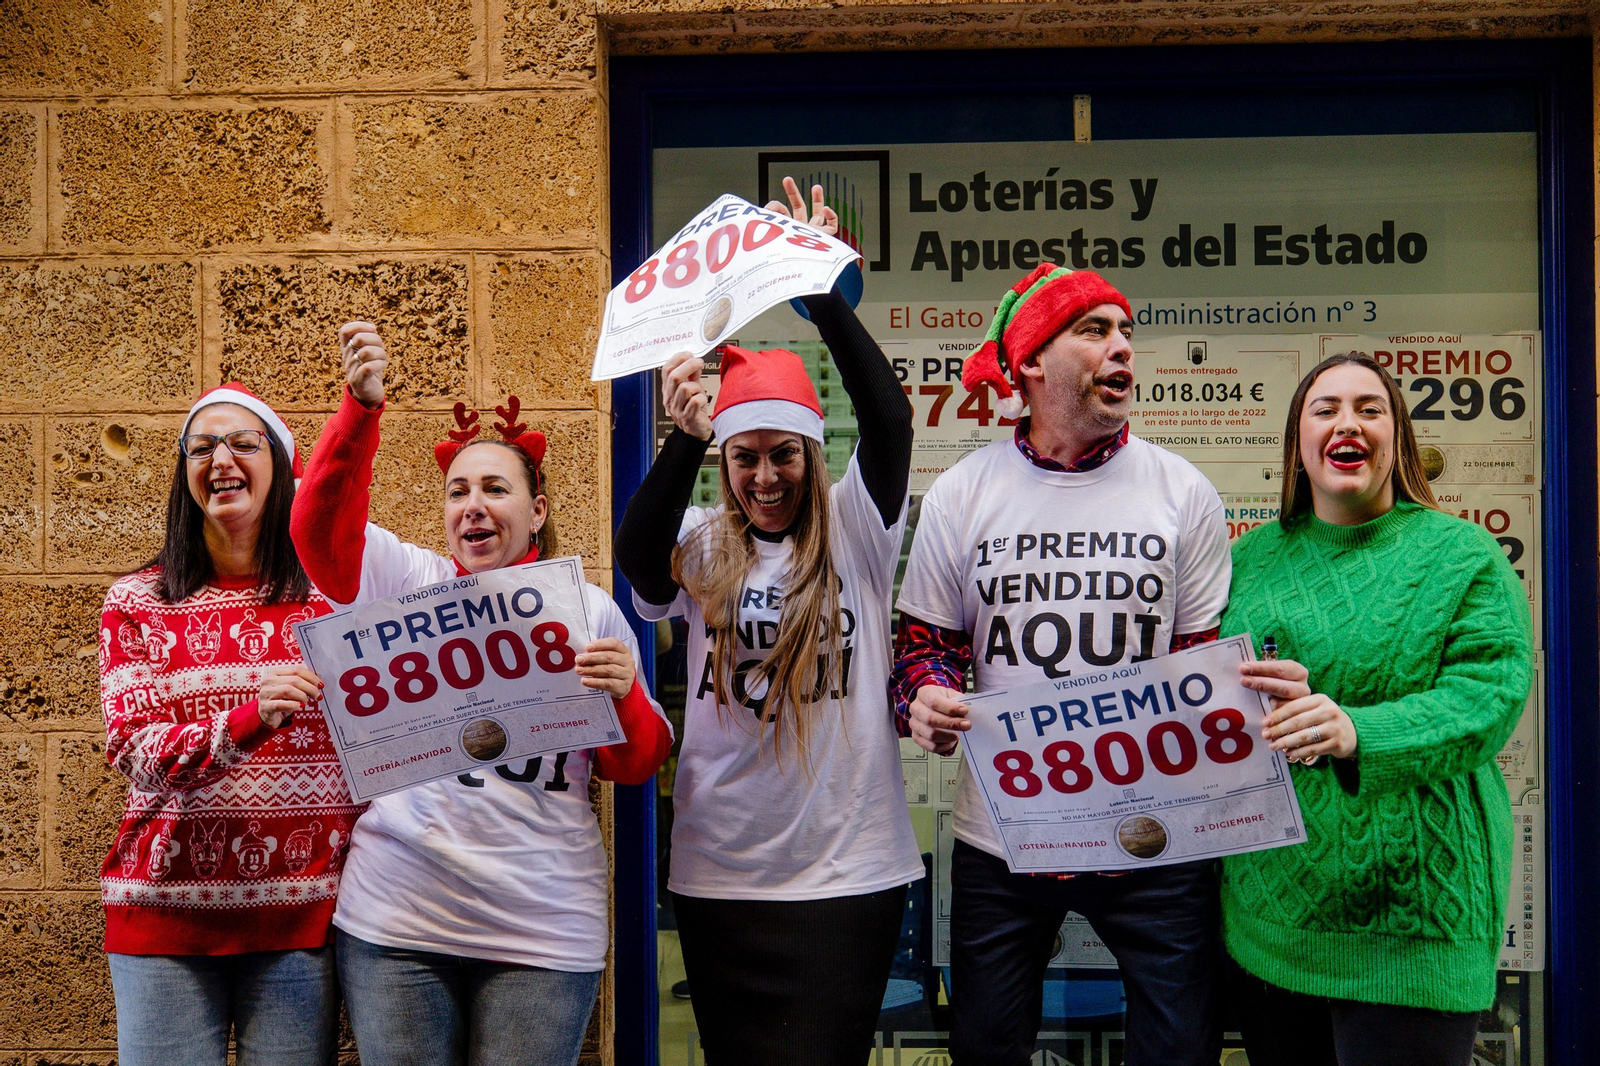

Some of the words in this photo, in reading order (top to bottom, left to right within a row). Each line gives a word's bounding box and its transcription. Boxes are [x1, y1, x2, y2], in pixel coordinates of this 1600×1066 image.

[909, 167, 1114, 213] Loterías
[1129, 178, 1159, 222] y
[624, 218, 833, 304] 88008
[911, 227, 1146, 282] Apuestas
[1161, 222, 1237, 268] del
[1253, 220, 1428, 266] Estado
[757, 272, 804, 293] DICIEMBRE
[671, 305, 684, 314] HAY
[890, 307, 910, 329] El
[920, 307, 984, 329] Gato
[1363, 301, 1377, 322] 3
[1388, 335, 1435, 344] VENDIDO
[1437, 333, 1462, 344] AQUÍ
[1156, 367, 1188, 375] Hemos
[1190, 367, 1238, 376] entregado
[1373, 349, 1513, 376] PREMIO
[1134, 382, 1243, 403] 1.018.034
[1249, 382, 1265, 403] €
[1142, 408, 1179, 418] premios
[1190, 408, 1199, 417] lo
[1201, 408, 1226, 418] largo
[1228, 408, 1240, 417] de
[1242, 408, 1267, 417] 2022
[1180, 419, 1208, 427] punto
[1210, 418, 1222, 426] de
[1200, 436, 1212, 445] EL
[1215, 436, 1242, 445] GATO
[1437, 493, 1462, 503] AQUÍ
[976, 536, 1010, 568] 1er
[1015, 532, 1167, 562] PREMIO
[397, 584, 449, 606] VENDIDO
[452, 576, 480, 592] AQUÍ
[976, 570, 1164, 606] VENDIDO
[342, 627, 373, 659] 1er
[375, 587, 544, 652] PREMIO
[985, 607, 1162, 680] AQUÍ
[338, 621, 577, 717] 88008
[1053, 673, 1108, 691] VENDIDO
[1111, 664, 1143, 680] AQUÍ
[408, 725, 418, 733] NO
[418, 721, 433, 730] HAY
[433, 715, 456, 727] MAYOR
[455, 709, 480, 720] SUERTE
[479, 705, 493, 714] QUE
[493, 703, 503, 711] LA
[512, 696, 544, 706] TENERNOS
[996, 709, 1027, 742] 1er
[1029, 672, 1214, 738] PREMIO
[530, 724, 542, 734] 22
[543, 718, 590, 732] DICIEMBRE
[992, 707, 1254, 798] 88008
[1087, 810, 1111, 819] MAYOR
[1111, 806, 1137, 815] SUERTE
[1138, 803, 1152, 811] QUE
[1173, 793, 1211, 805] TENERNOS
[1193, 824, 1207, 834] 22
[1208, 813, 1265, 832] DICIEMBRE
